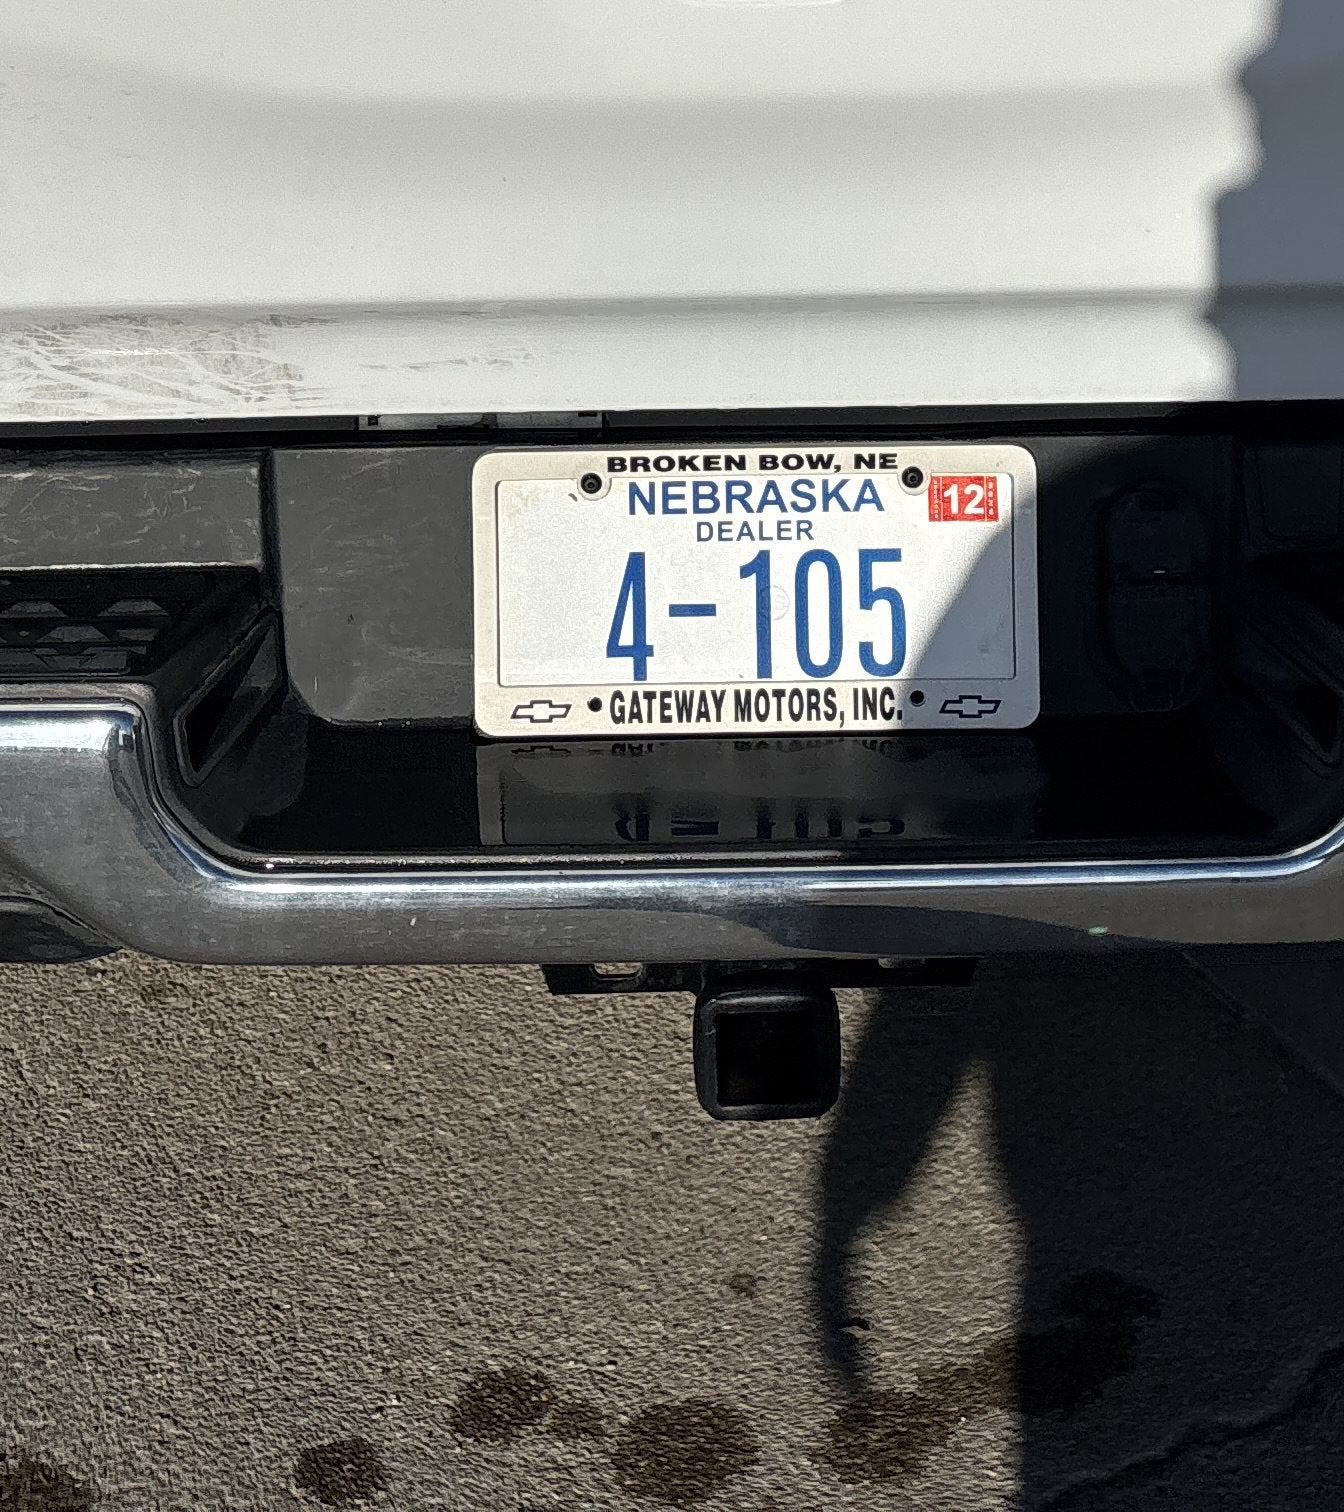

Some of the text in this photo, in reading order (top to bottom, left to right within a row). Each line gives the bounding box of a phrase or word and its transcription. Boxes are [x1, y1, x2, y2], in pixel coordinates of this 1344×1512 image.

[607, 453, 898, 473] BROKEN BOW, NE
[628, 478, 885, 515] NEBRASKA
[943, 483, 985, 515] 12
[696, 519, 815, 542] DEALER
[606, 548, 907, 681] 4-105
[609, 687, 903, 728] GATEWAY MOTORS, INC.
